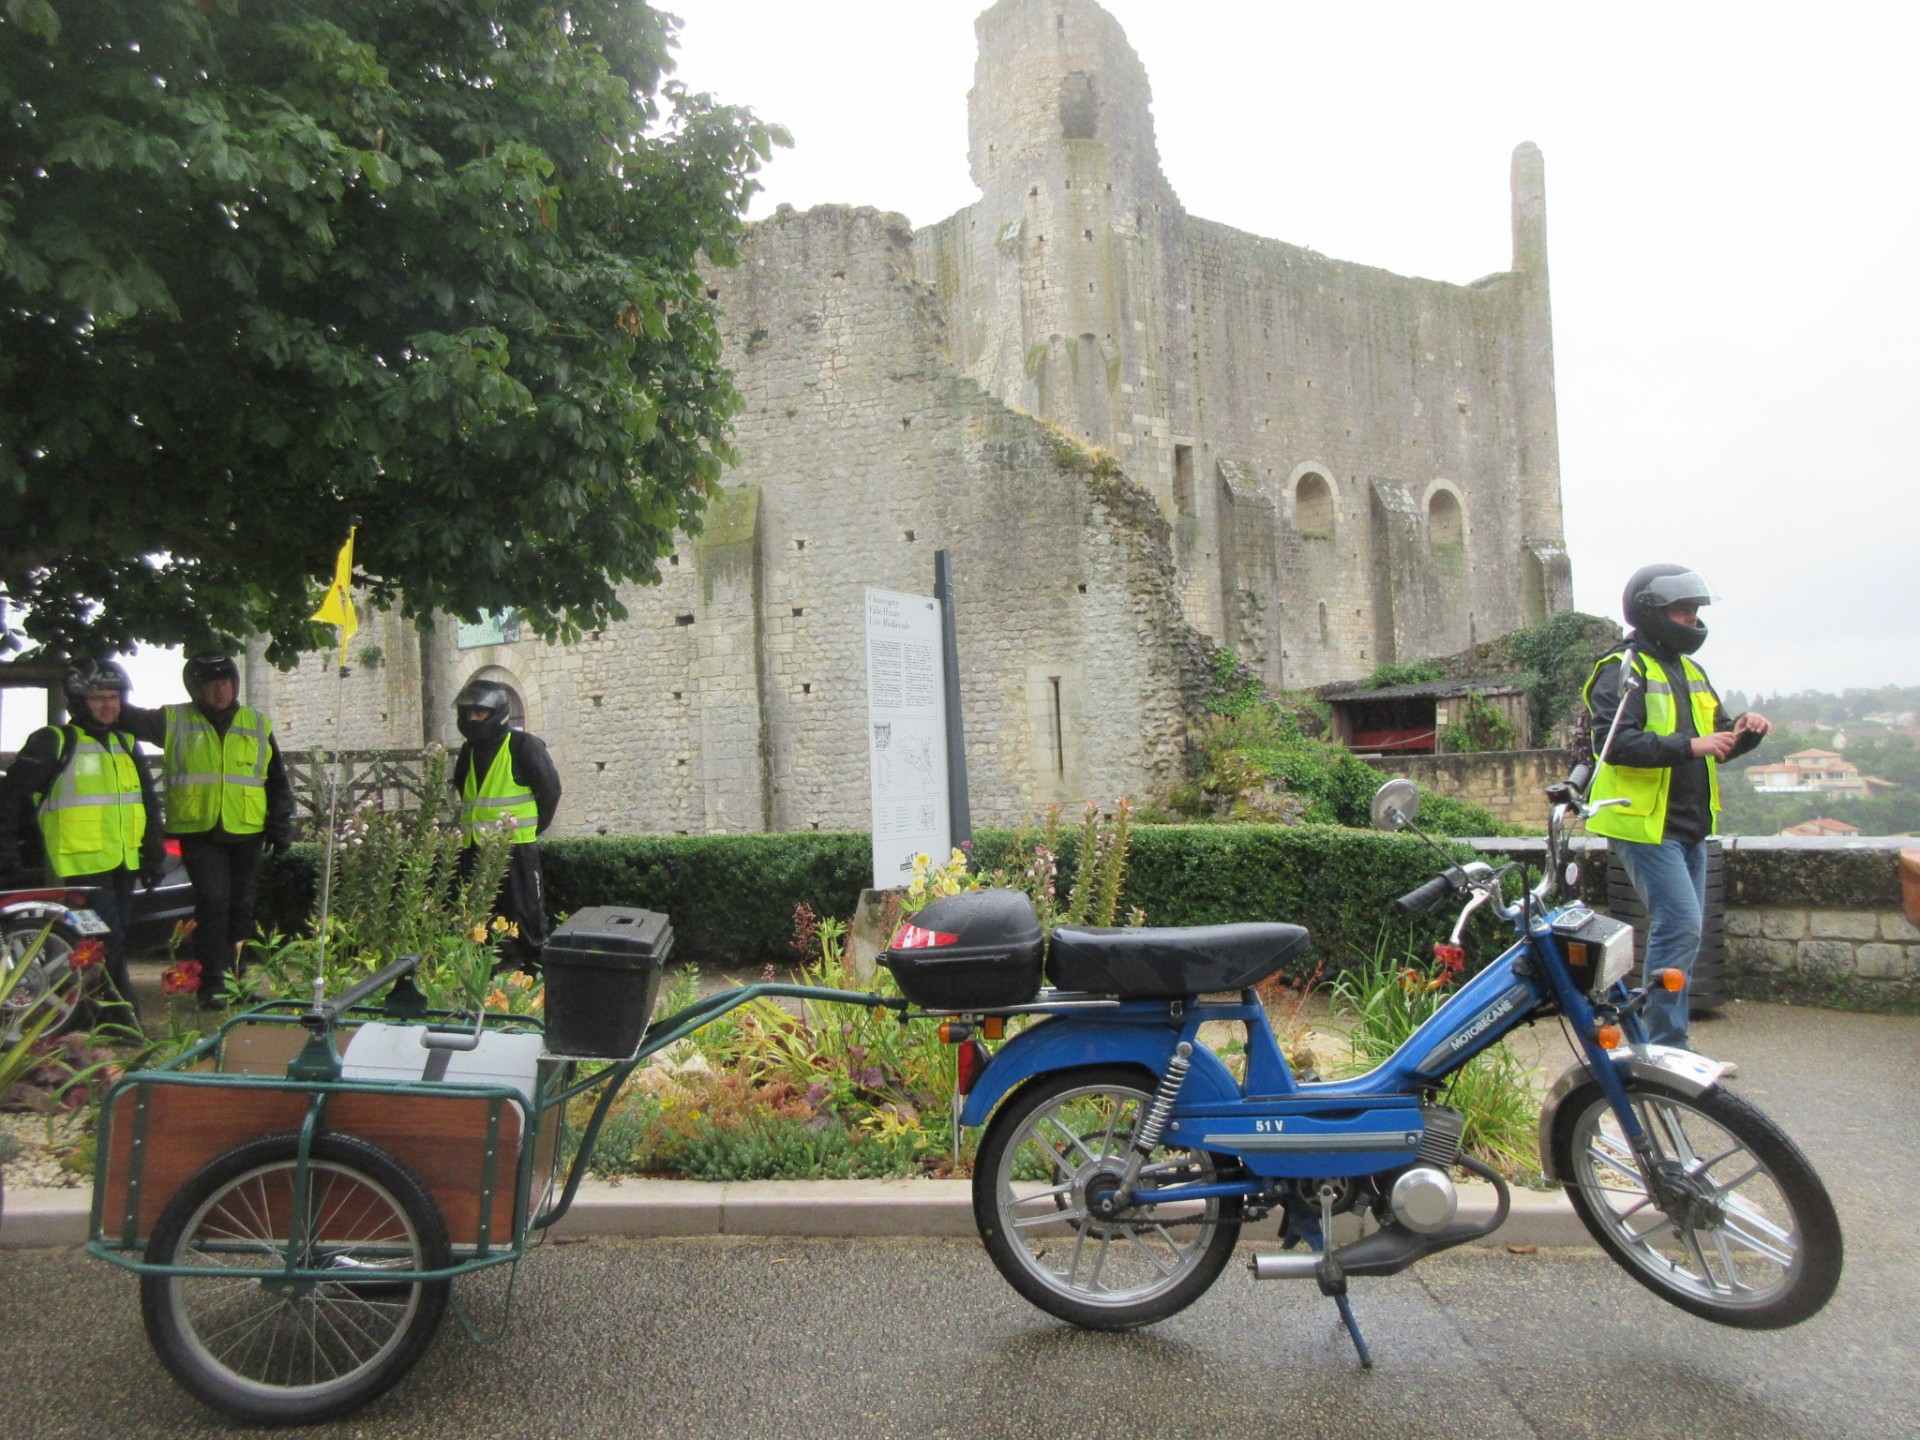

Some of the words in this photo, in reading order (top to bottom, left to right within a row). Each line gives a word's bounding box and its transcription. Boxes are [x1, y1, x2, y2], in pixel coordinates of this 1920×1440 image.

[1450, 1000, 1513, 1051] MOTOBECANE
[1256, 1120, 1271, 1132] 51
[1275, 1120, 1284, 1132] V
